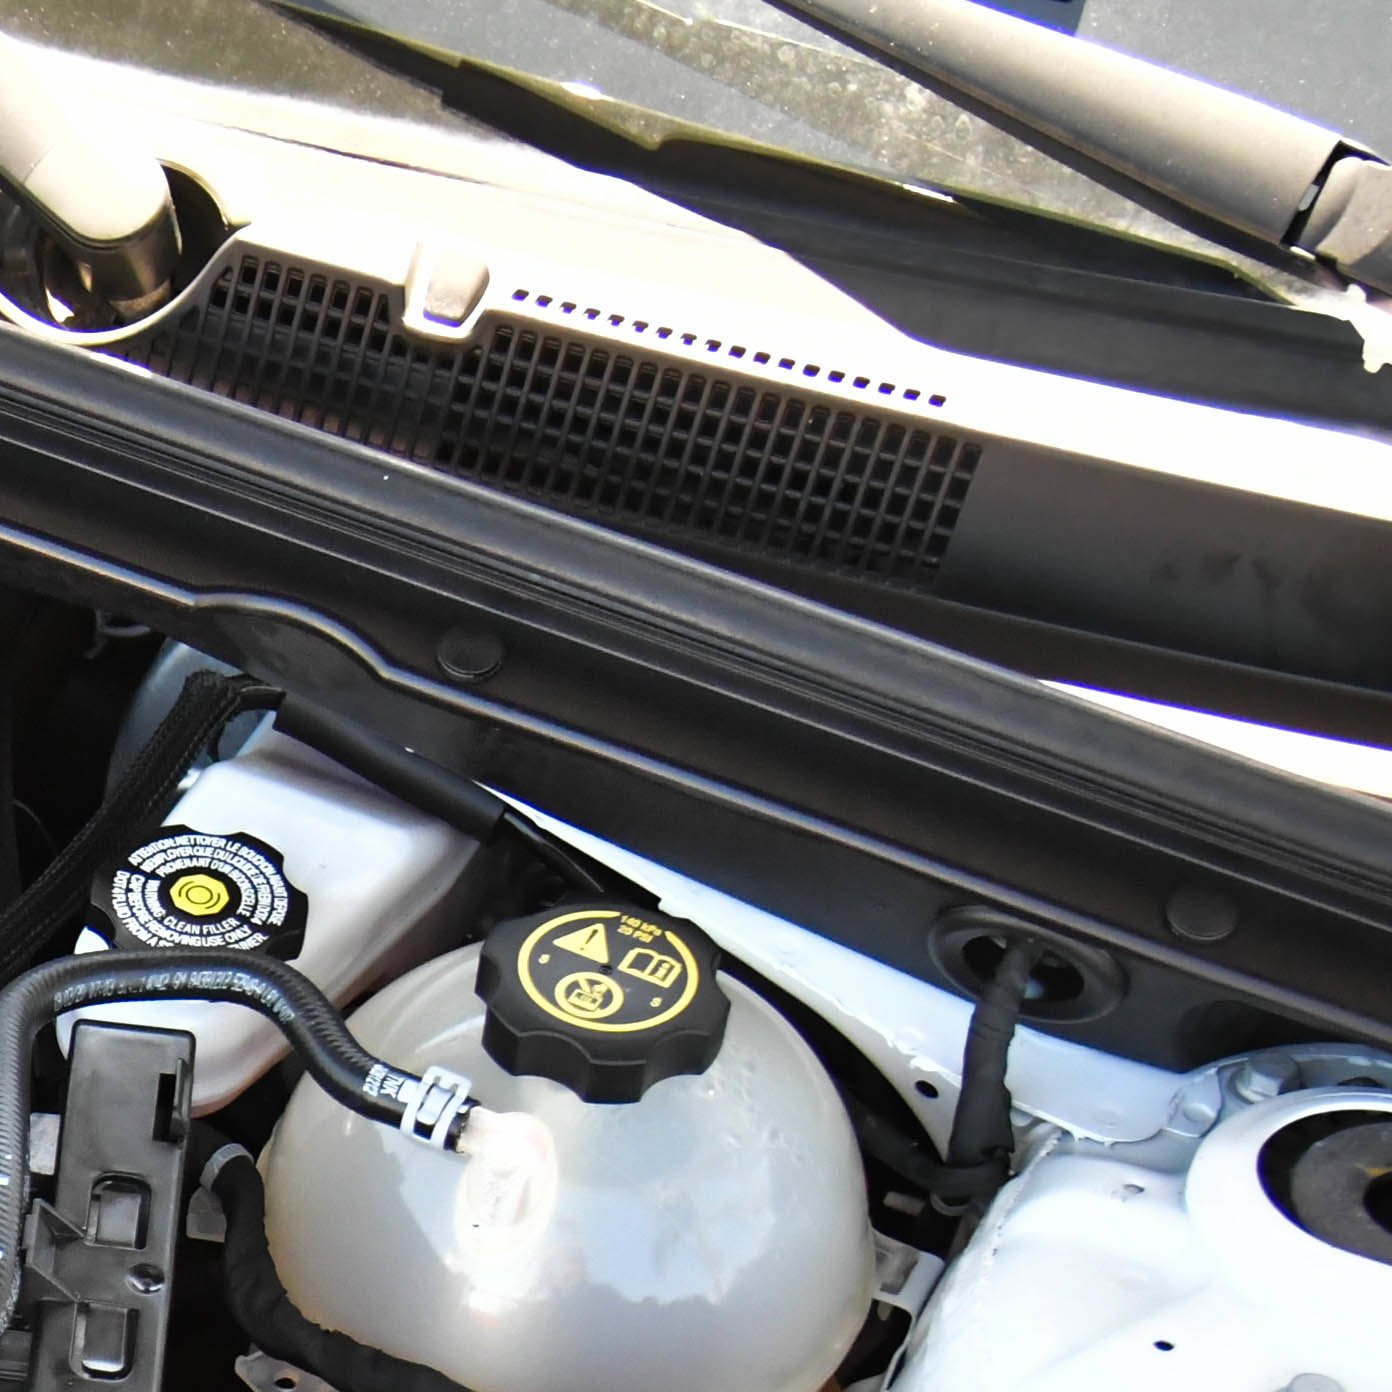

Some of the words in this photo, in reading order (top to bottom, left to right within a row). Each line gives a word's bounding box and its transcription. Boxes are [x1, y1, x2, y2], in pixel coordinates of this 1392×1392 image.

[226, 840, 240, 851] LE
[129, 874, 145, 892] CAP
[128, 892, 152, 927] BEFORE
[112, 894, 130, 918] FLUID
[123, 918, 149, 944] FROM
[146, 937, 155, 947] A
[165, 916, 200, 935] CLEAN
[202, 918, 241, 935] FILLER
[146, 921, 201, 947] REMOVING
[201, 936, 224, 947] USE
[224, 925, 252, 942] ONLY
